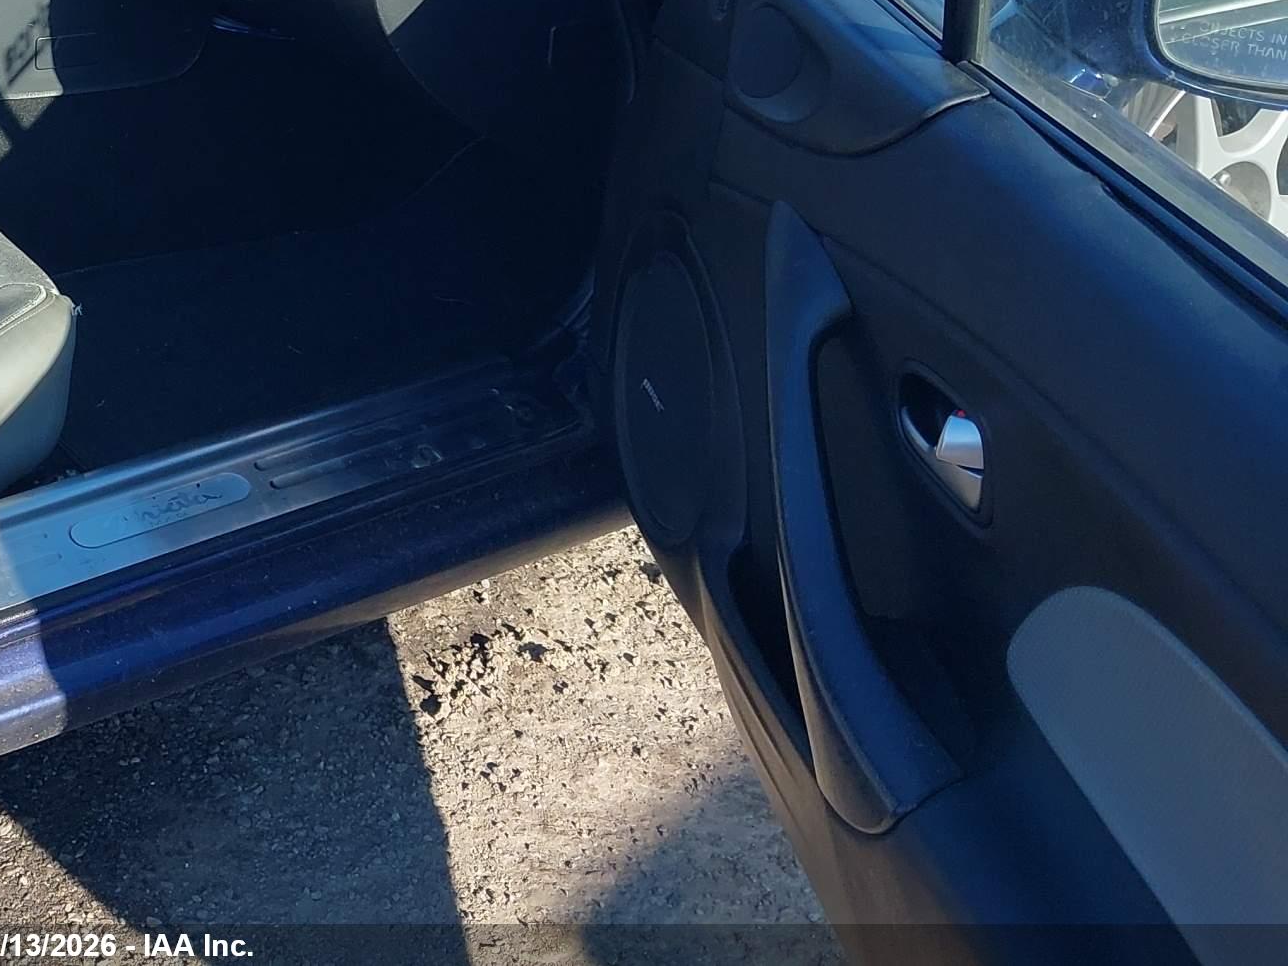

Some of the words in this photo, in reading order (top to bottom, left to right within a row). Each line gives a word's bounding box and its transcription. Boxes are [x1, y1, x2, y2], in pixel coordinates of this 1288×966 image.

[1182, 32, 1241, 52] CLOSER
[1248, 43, 1288, 61] THAN
[1199, 20, 1265, 42] OBJECTS
[1271, 33, 1288, 46] IN
